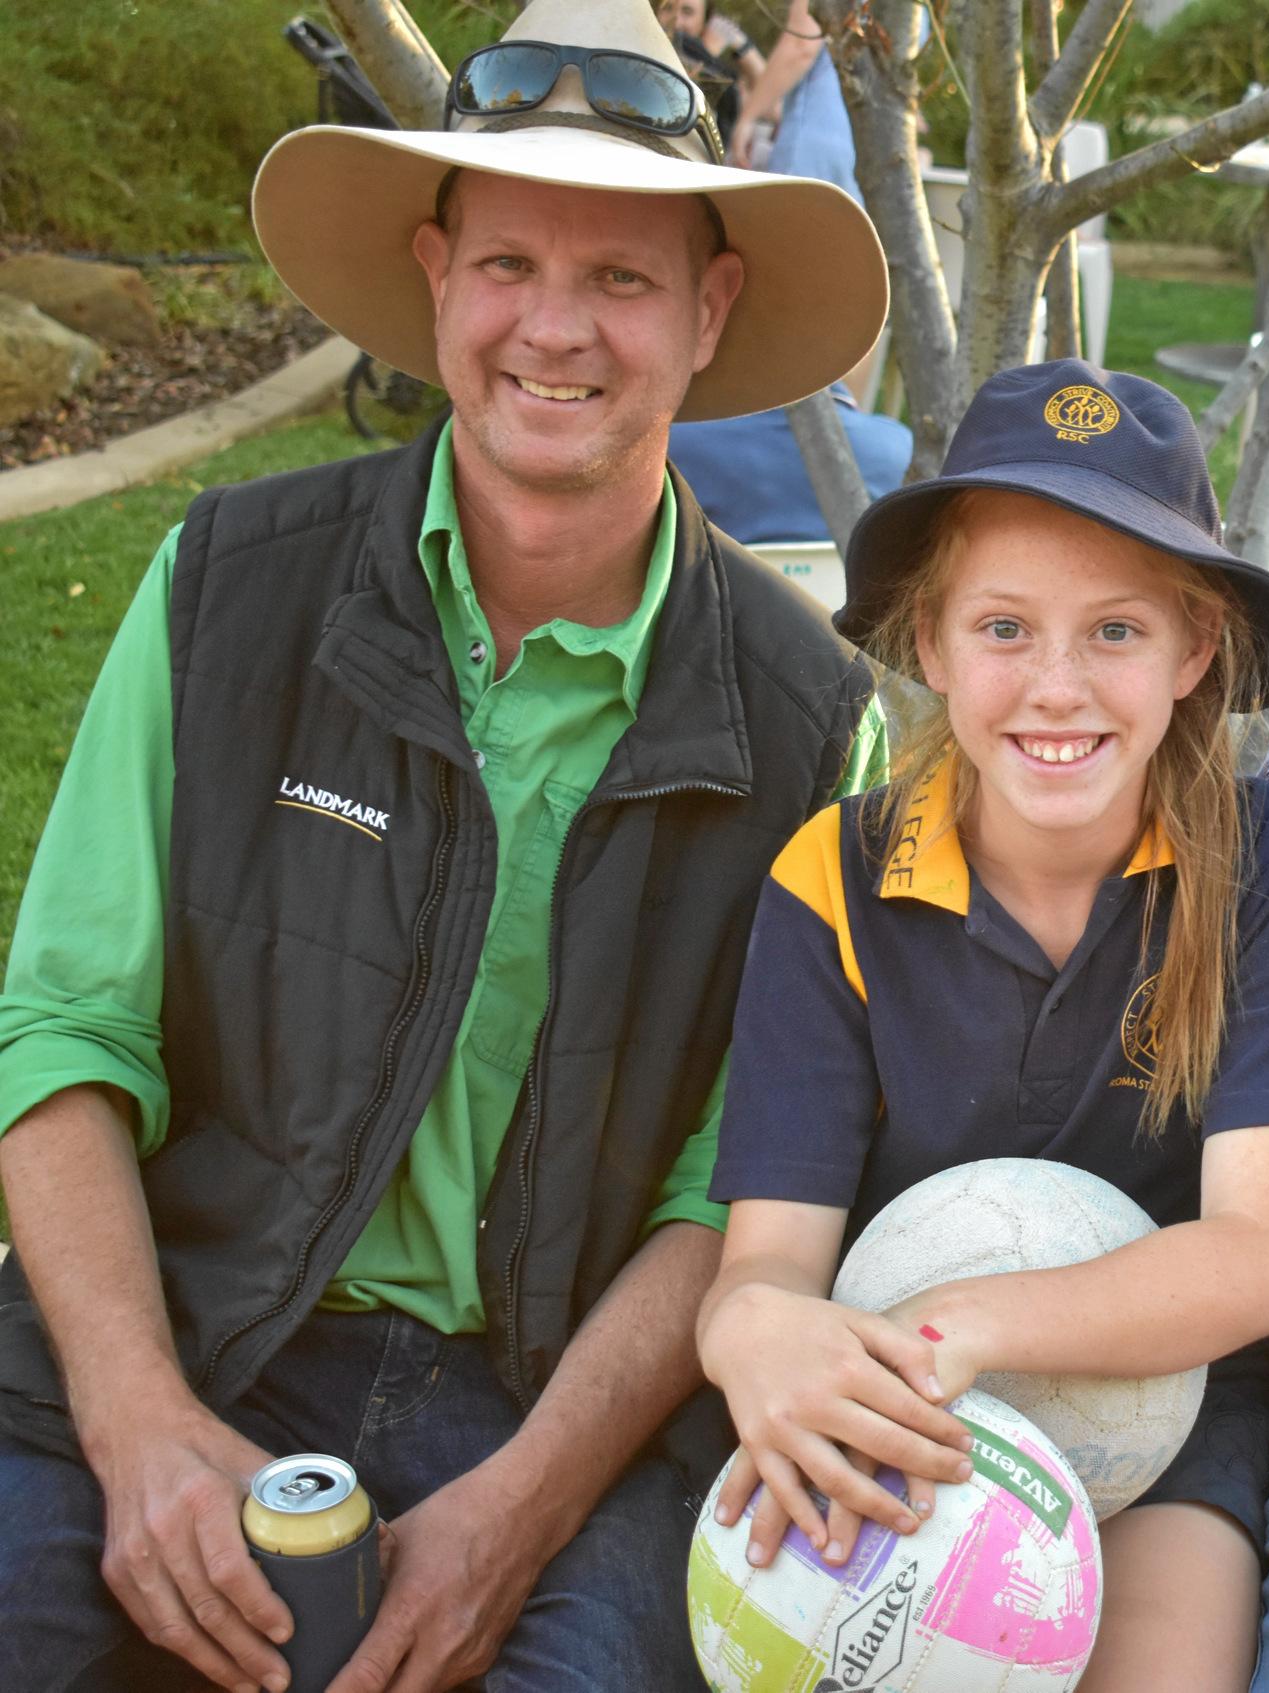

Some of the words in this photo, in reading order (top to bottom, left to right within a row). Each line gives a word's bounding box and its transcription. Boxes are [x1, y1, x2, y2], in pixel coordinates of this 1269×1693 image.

[1056, 430, 1090, 444] RSC
[280, 776, 391, 830] LANDMARK
[919, 1585, 937, 1606] 1969
